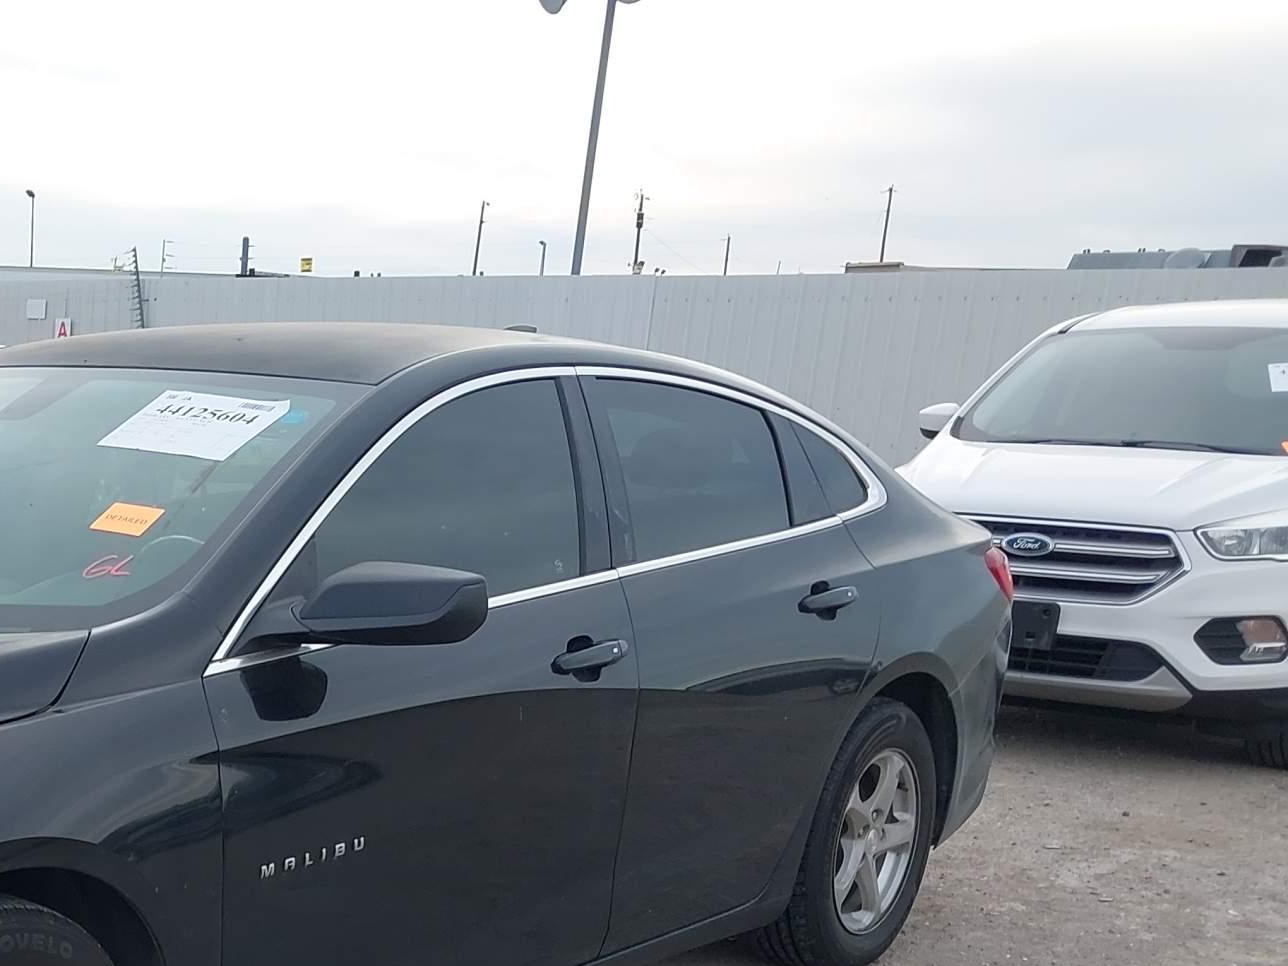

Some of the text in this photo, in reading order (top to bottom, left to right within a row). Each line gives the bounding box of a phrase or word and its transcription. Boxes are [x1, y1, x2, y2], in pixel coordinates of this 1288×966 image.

[57, 321, 67, 338] A
[156, 403, 259, 424] 44125604
[1013, 537, 1041, 549] Ford
[260, 836, 366, 879] MALIBU
